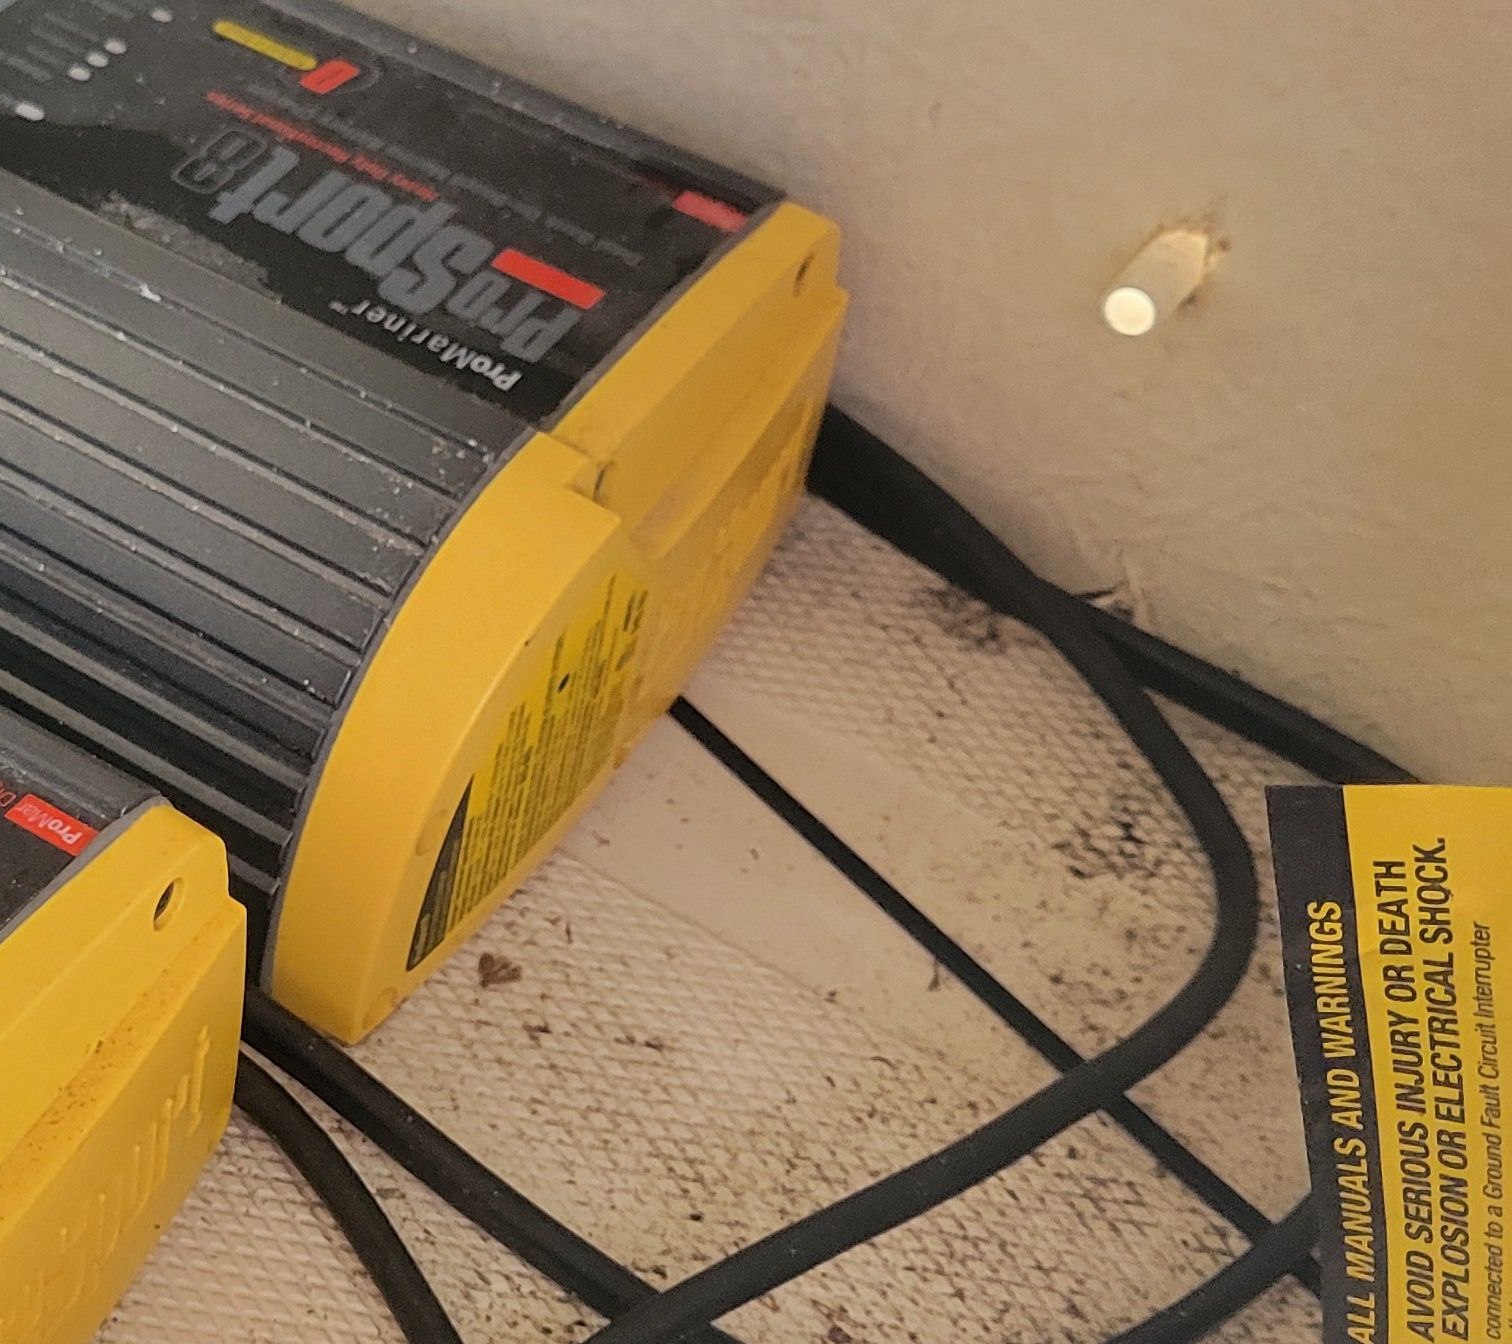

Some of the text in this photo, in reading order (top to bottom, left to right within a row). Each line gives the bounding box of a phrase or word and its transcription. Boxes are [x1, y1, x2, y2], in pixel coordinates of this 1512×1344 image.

[162, 124, 275, 194] 8
[1372, 860, 1412, 957] DEATH
[1413, 836, 1454, 945] SHOCK.
[1307, 900, 1356, 1058] WARNINGS
[1380, 963, 1416, 1002] OR
[1470, 921, 1496, 1019] Interrupter
[1381, 1008, 1425, 1117] INJURY
[1417, 950, 1466, 1124] ELECTRICAL
[1470, 1023, 1497, 1078] Circuit
[1324, 1068, 1362, 1129] AND
[1473, 1081, 1500, 1128] Fault
[1390, 1123, 1434, 1244] SERIOUS
[1427, 1130, 1466, 1171] OR
[1476, 1131, 1502, 1200] Ground
[1333, 1138, 1375, 1281] MANUALS
[1479, 1221, 1501, 1240] to
[1482, 1204, 1500, 1218] a
[1398, 1254, 1436, 1342] AVOID
[1427, 1174, 1472, 1341] EXPLOSION
[1476, 1245, 1503, 1339] connected
